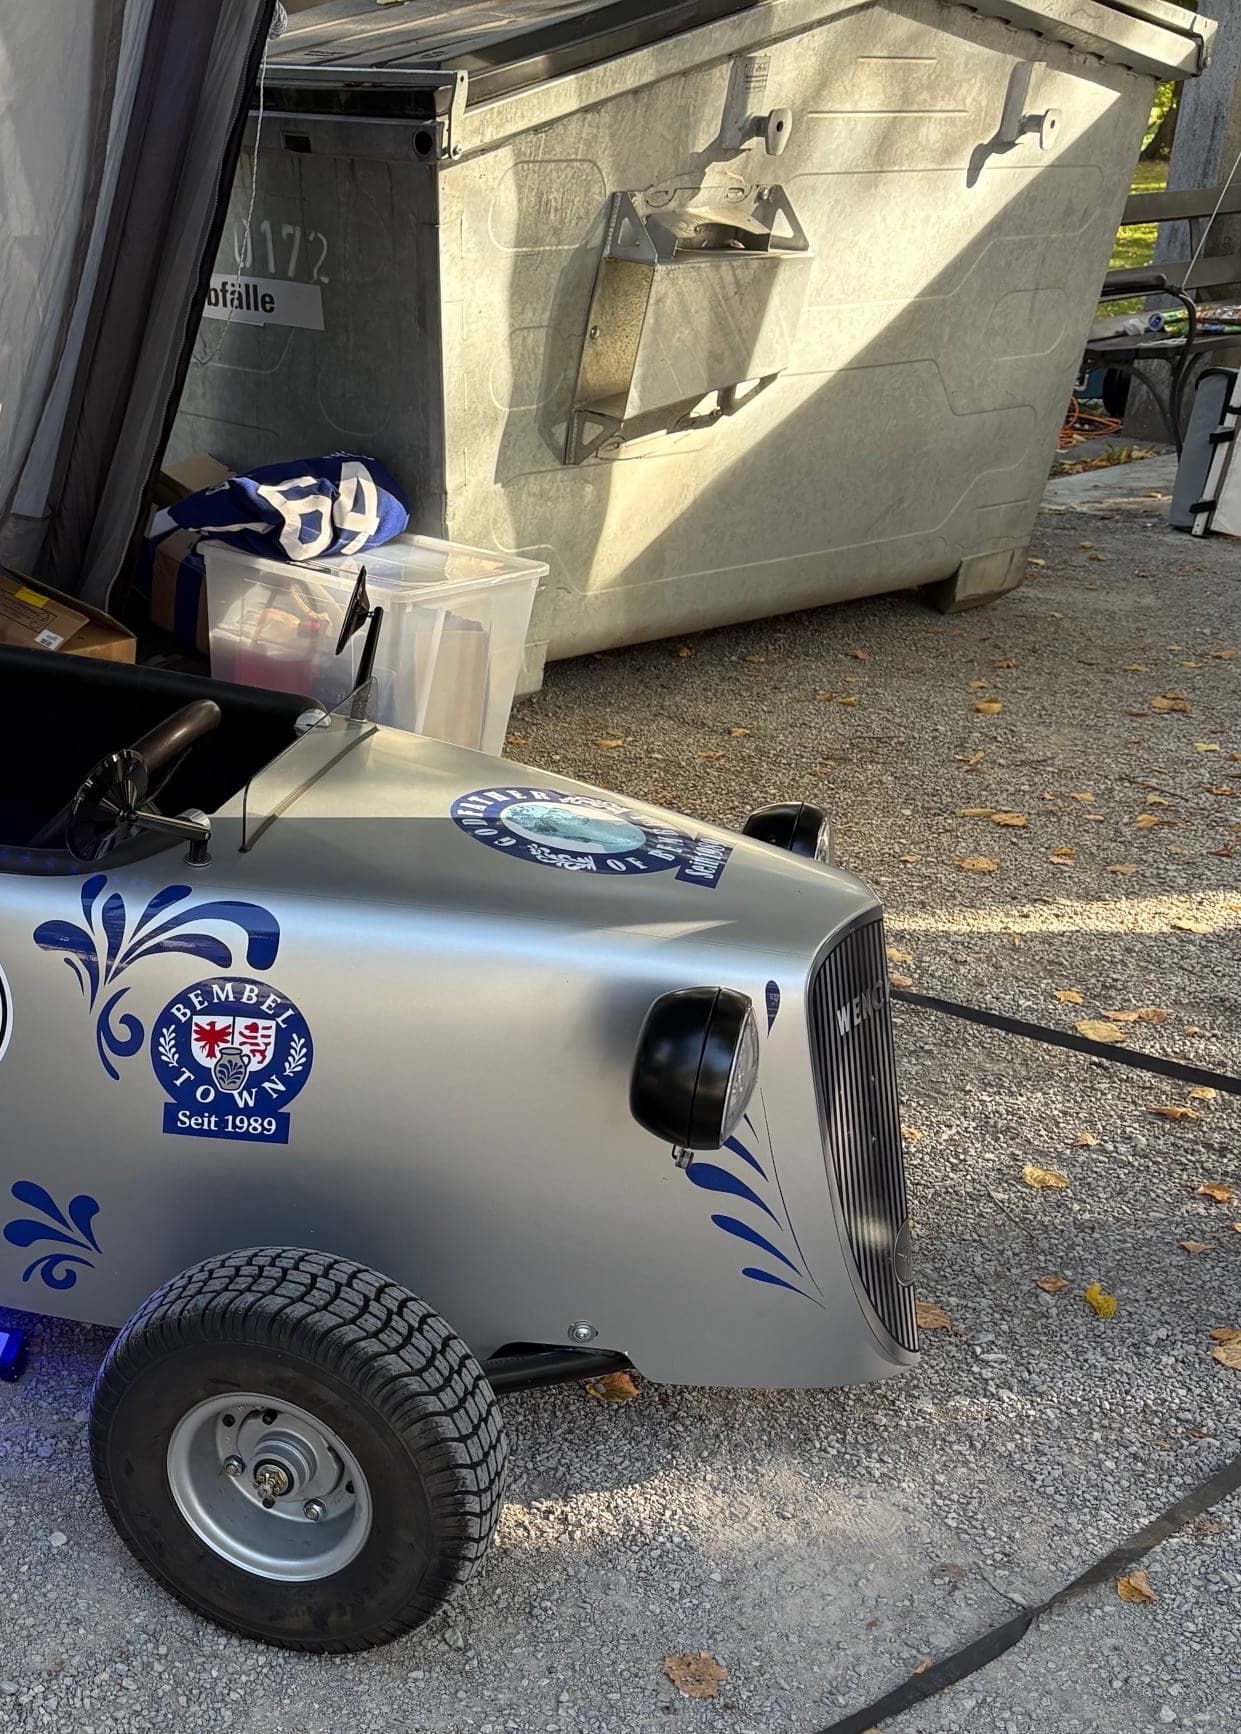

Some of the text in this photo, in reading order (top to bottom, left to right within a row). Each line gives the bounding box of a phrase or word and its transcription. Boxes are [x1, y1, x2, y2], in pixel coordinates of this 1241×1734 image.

[457, 789, 553, 847] GODFATHER
[170, 982, 295, 1028] BEMBEL
[173, 1068, 287, 1109] TOWN
[177, 1110, 277, 1135] Seit 1989
